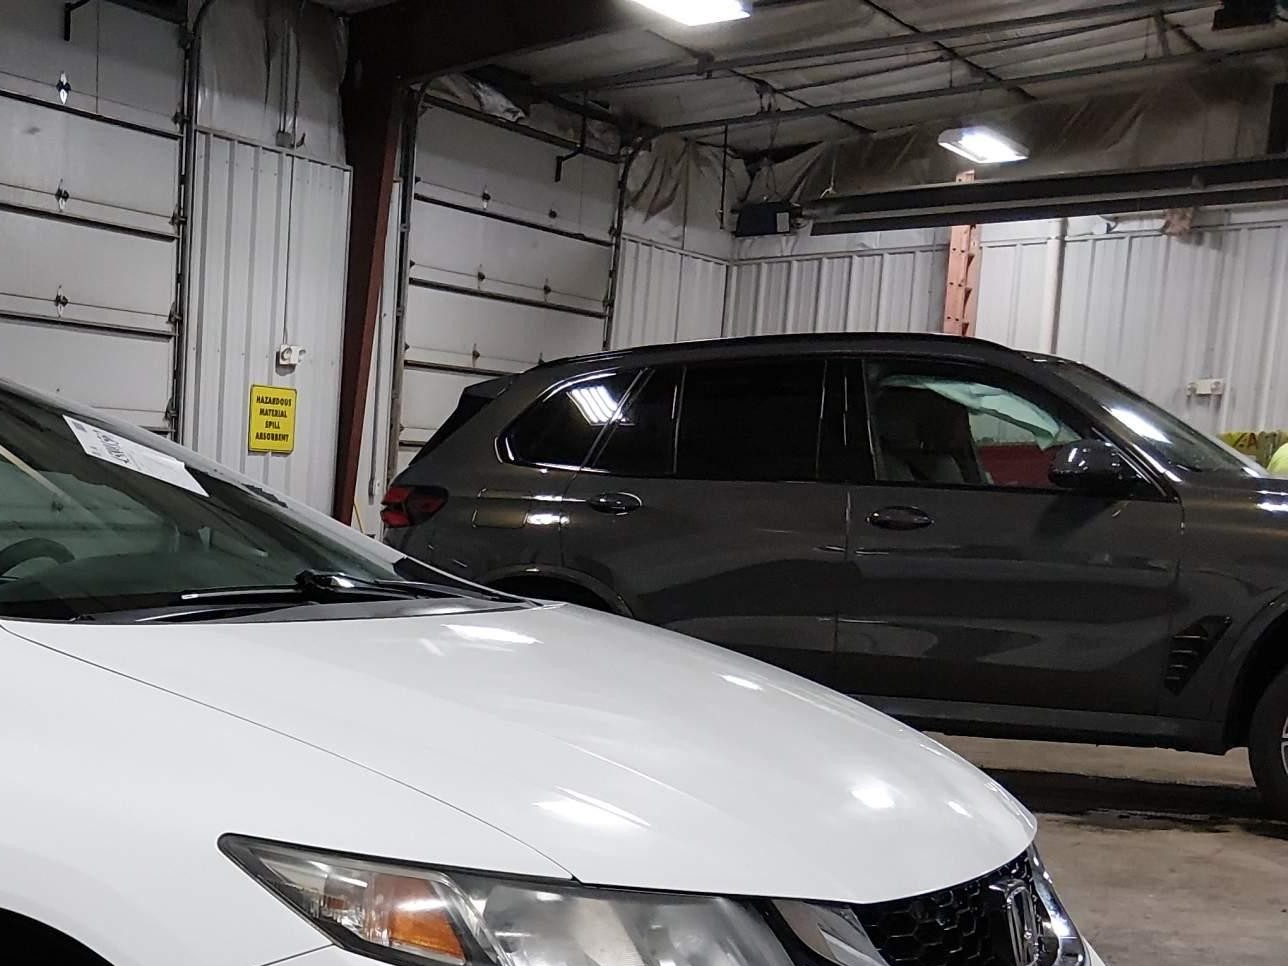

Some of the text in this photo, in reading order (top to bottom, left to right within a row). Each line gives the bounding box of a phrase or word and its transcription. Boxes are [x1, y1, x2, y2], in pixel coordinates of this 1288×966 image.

[256, 395, 292, 406] HAZARDOUS
[259, 408, 287, 418] MATERIAL
[265, 420, 280, 430] SPILL
[255, 431, 289, 442] ABSORBENT
